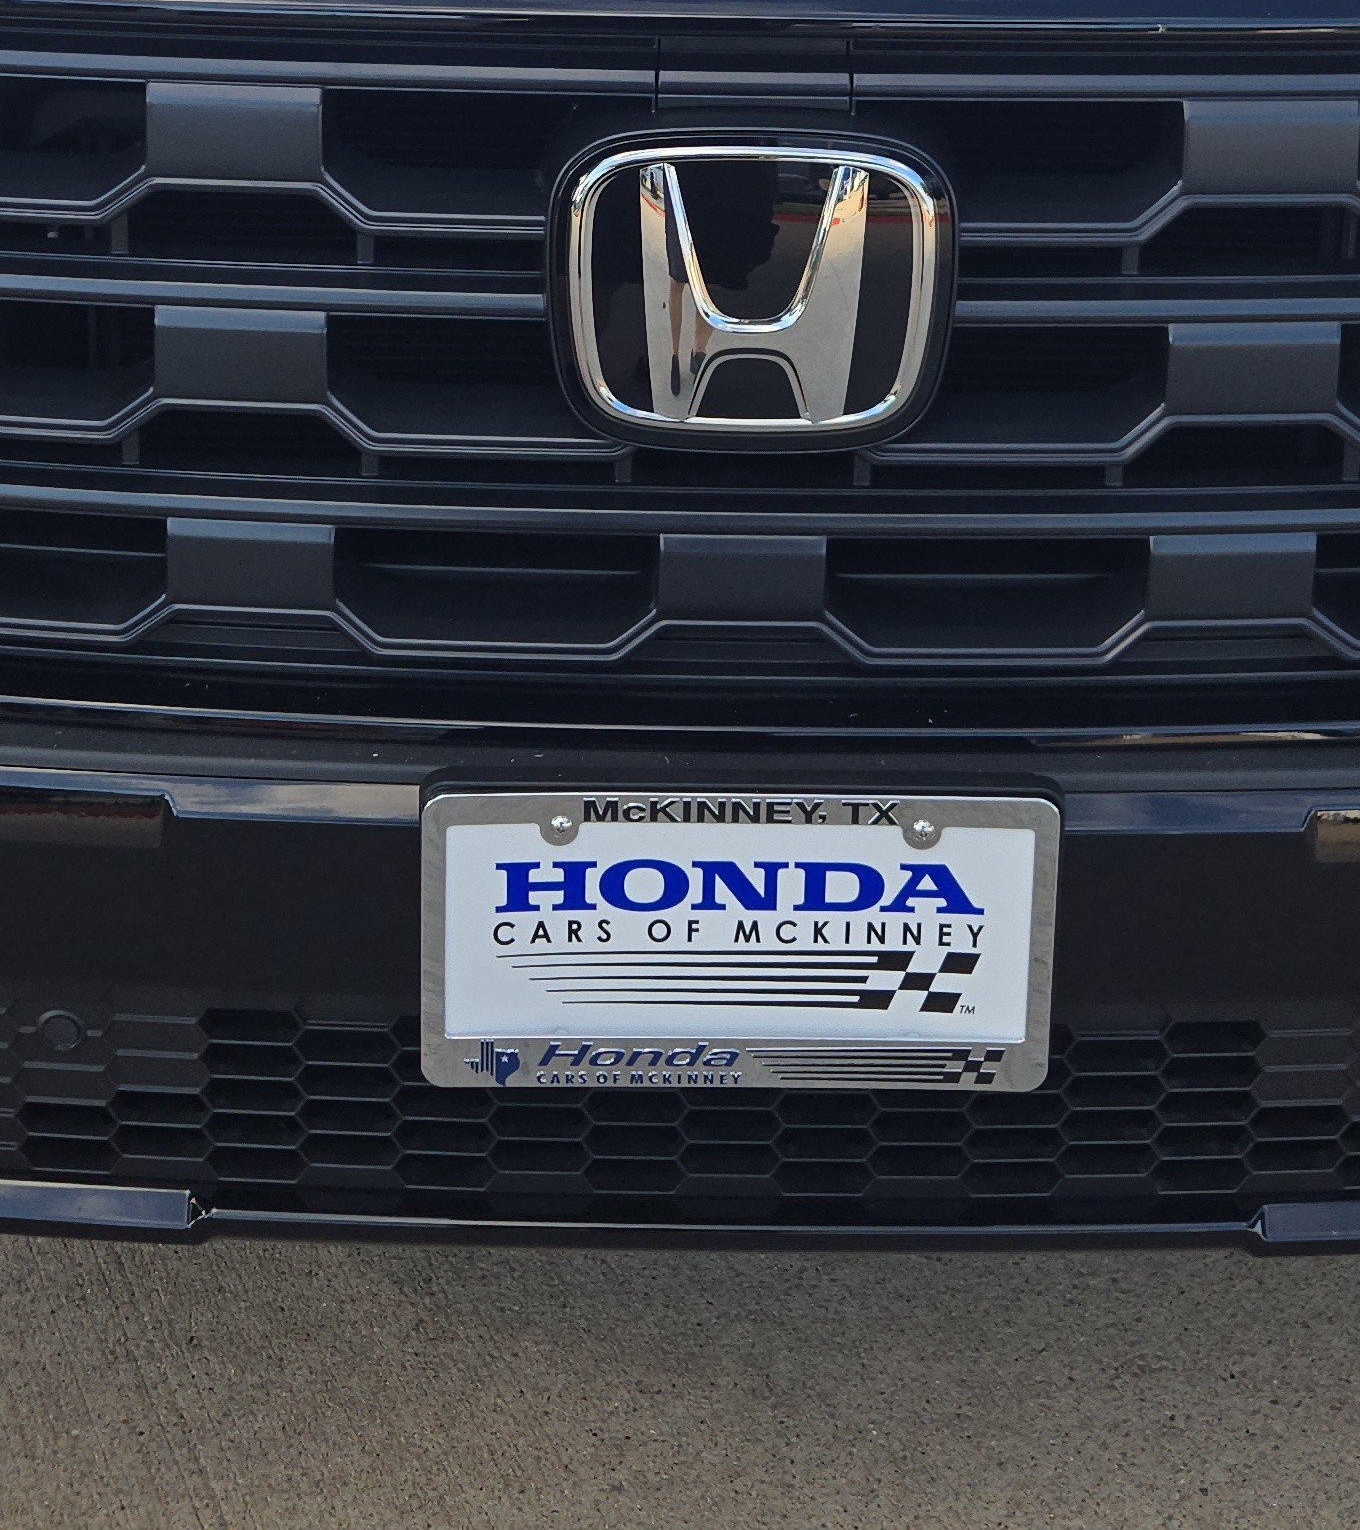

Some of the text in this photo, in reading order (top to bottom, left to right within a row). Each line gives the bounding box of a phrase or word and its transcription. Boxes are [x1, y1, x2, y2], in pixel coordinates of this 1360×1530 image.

[583, 797, 901, 825] McKINNEY, TX
[495, 858, 985, 916] HONDA
[493, 919, 985, 949] CARS OF MCKINNEY
[959, 1004, 976, 1015] TM
[539, 1041, 741, 1068] Honda
[536, 1070, 743, 1086] CARS OF MCKINNEY
